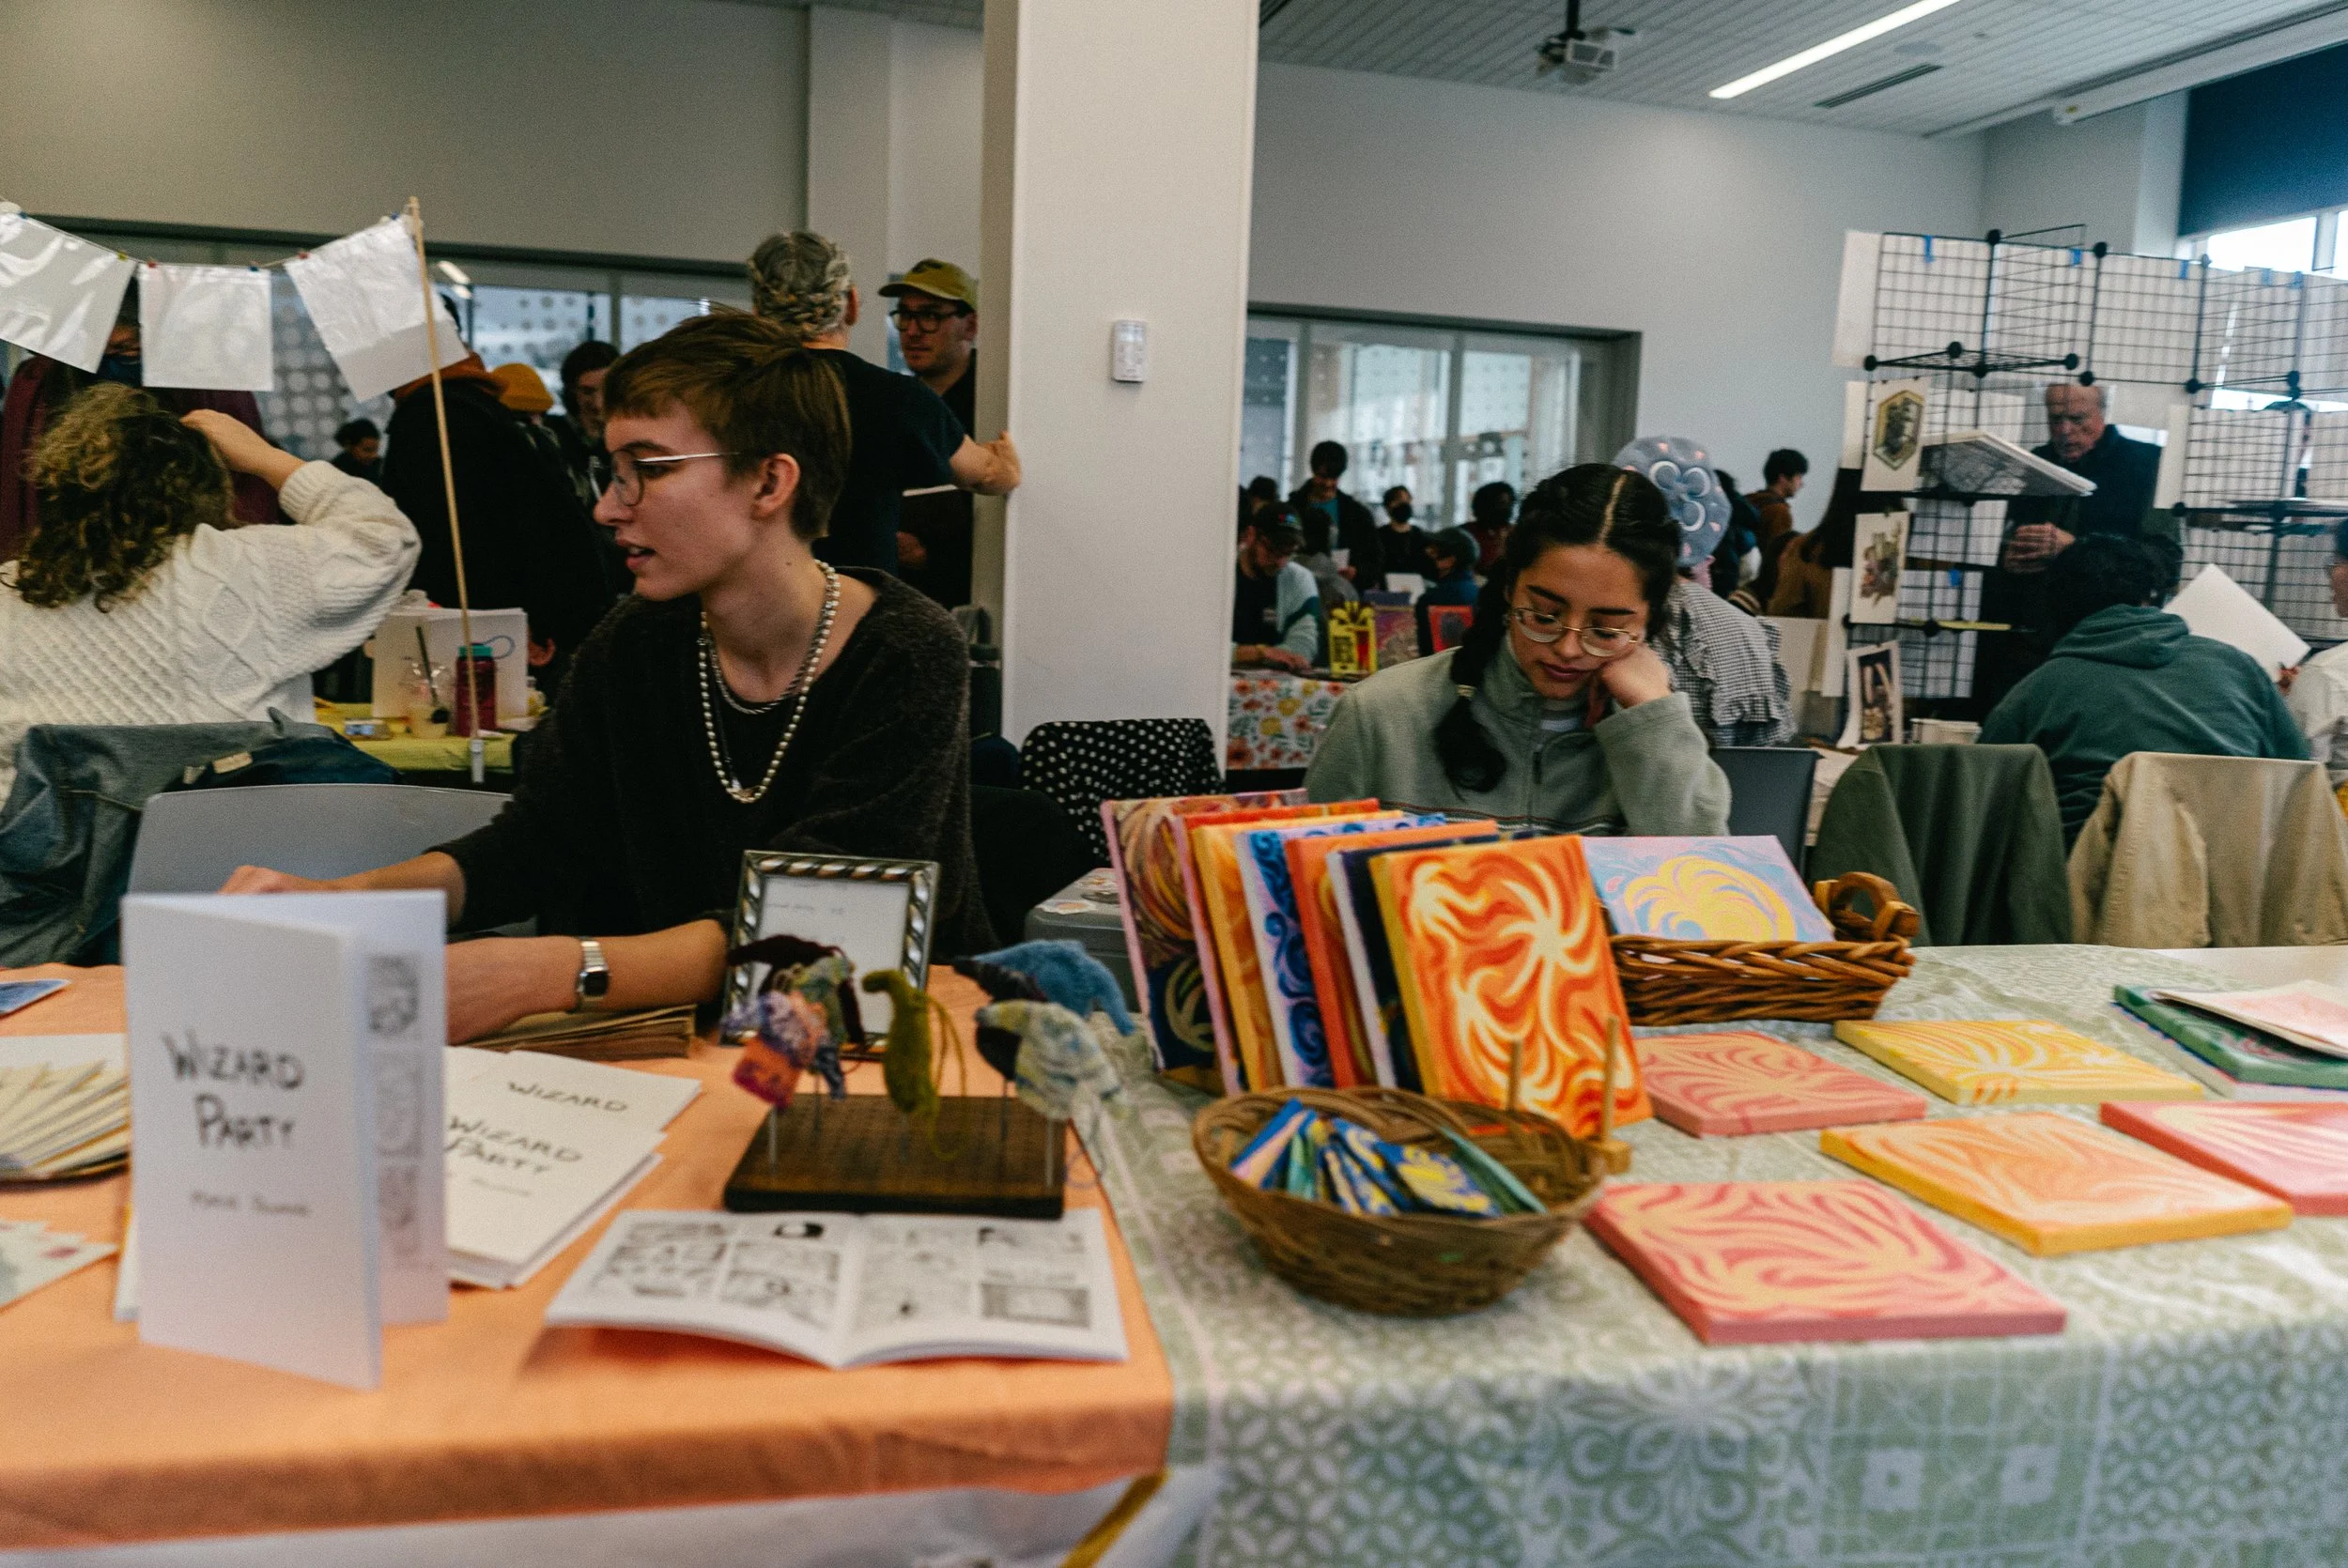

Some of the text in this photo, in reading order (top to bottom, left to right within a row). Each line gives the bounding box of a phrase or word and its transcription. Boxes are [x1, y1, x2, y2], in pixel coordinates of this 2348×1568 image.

[162, 1029, 305, 1089] WIZARD
[193, 1092, 296, 1149] PARTY
[507, 1082, 628, 1112] WIZARD
[447, 1115, 583, 1162] WIZARD
